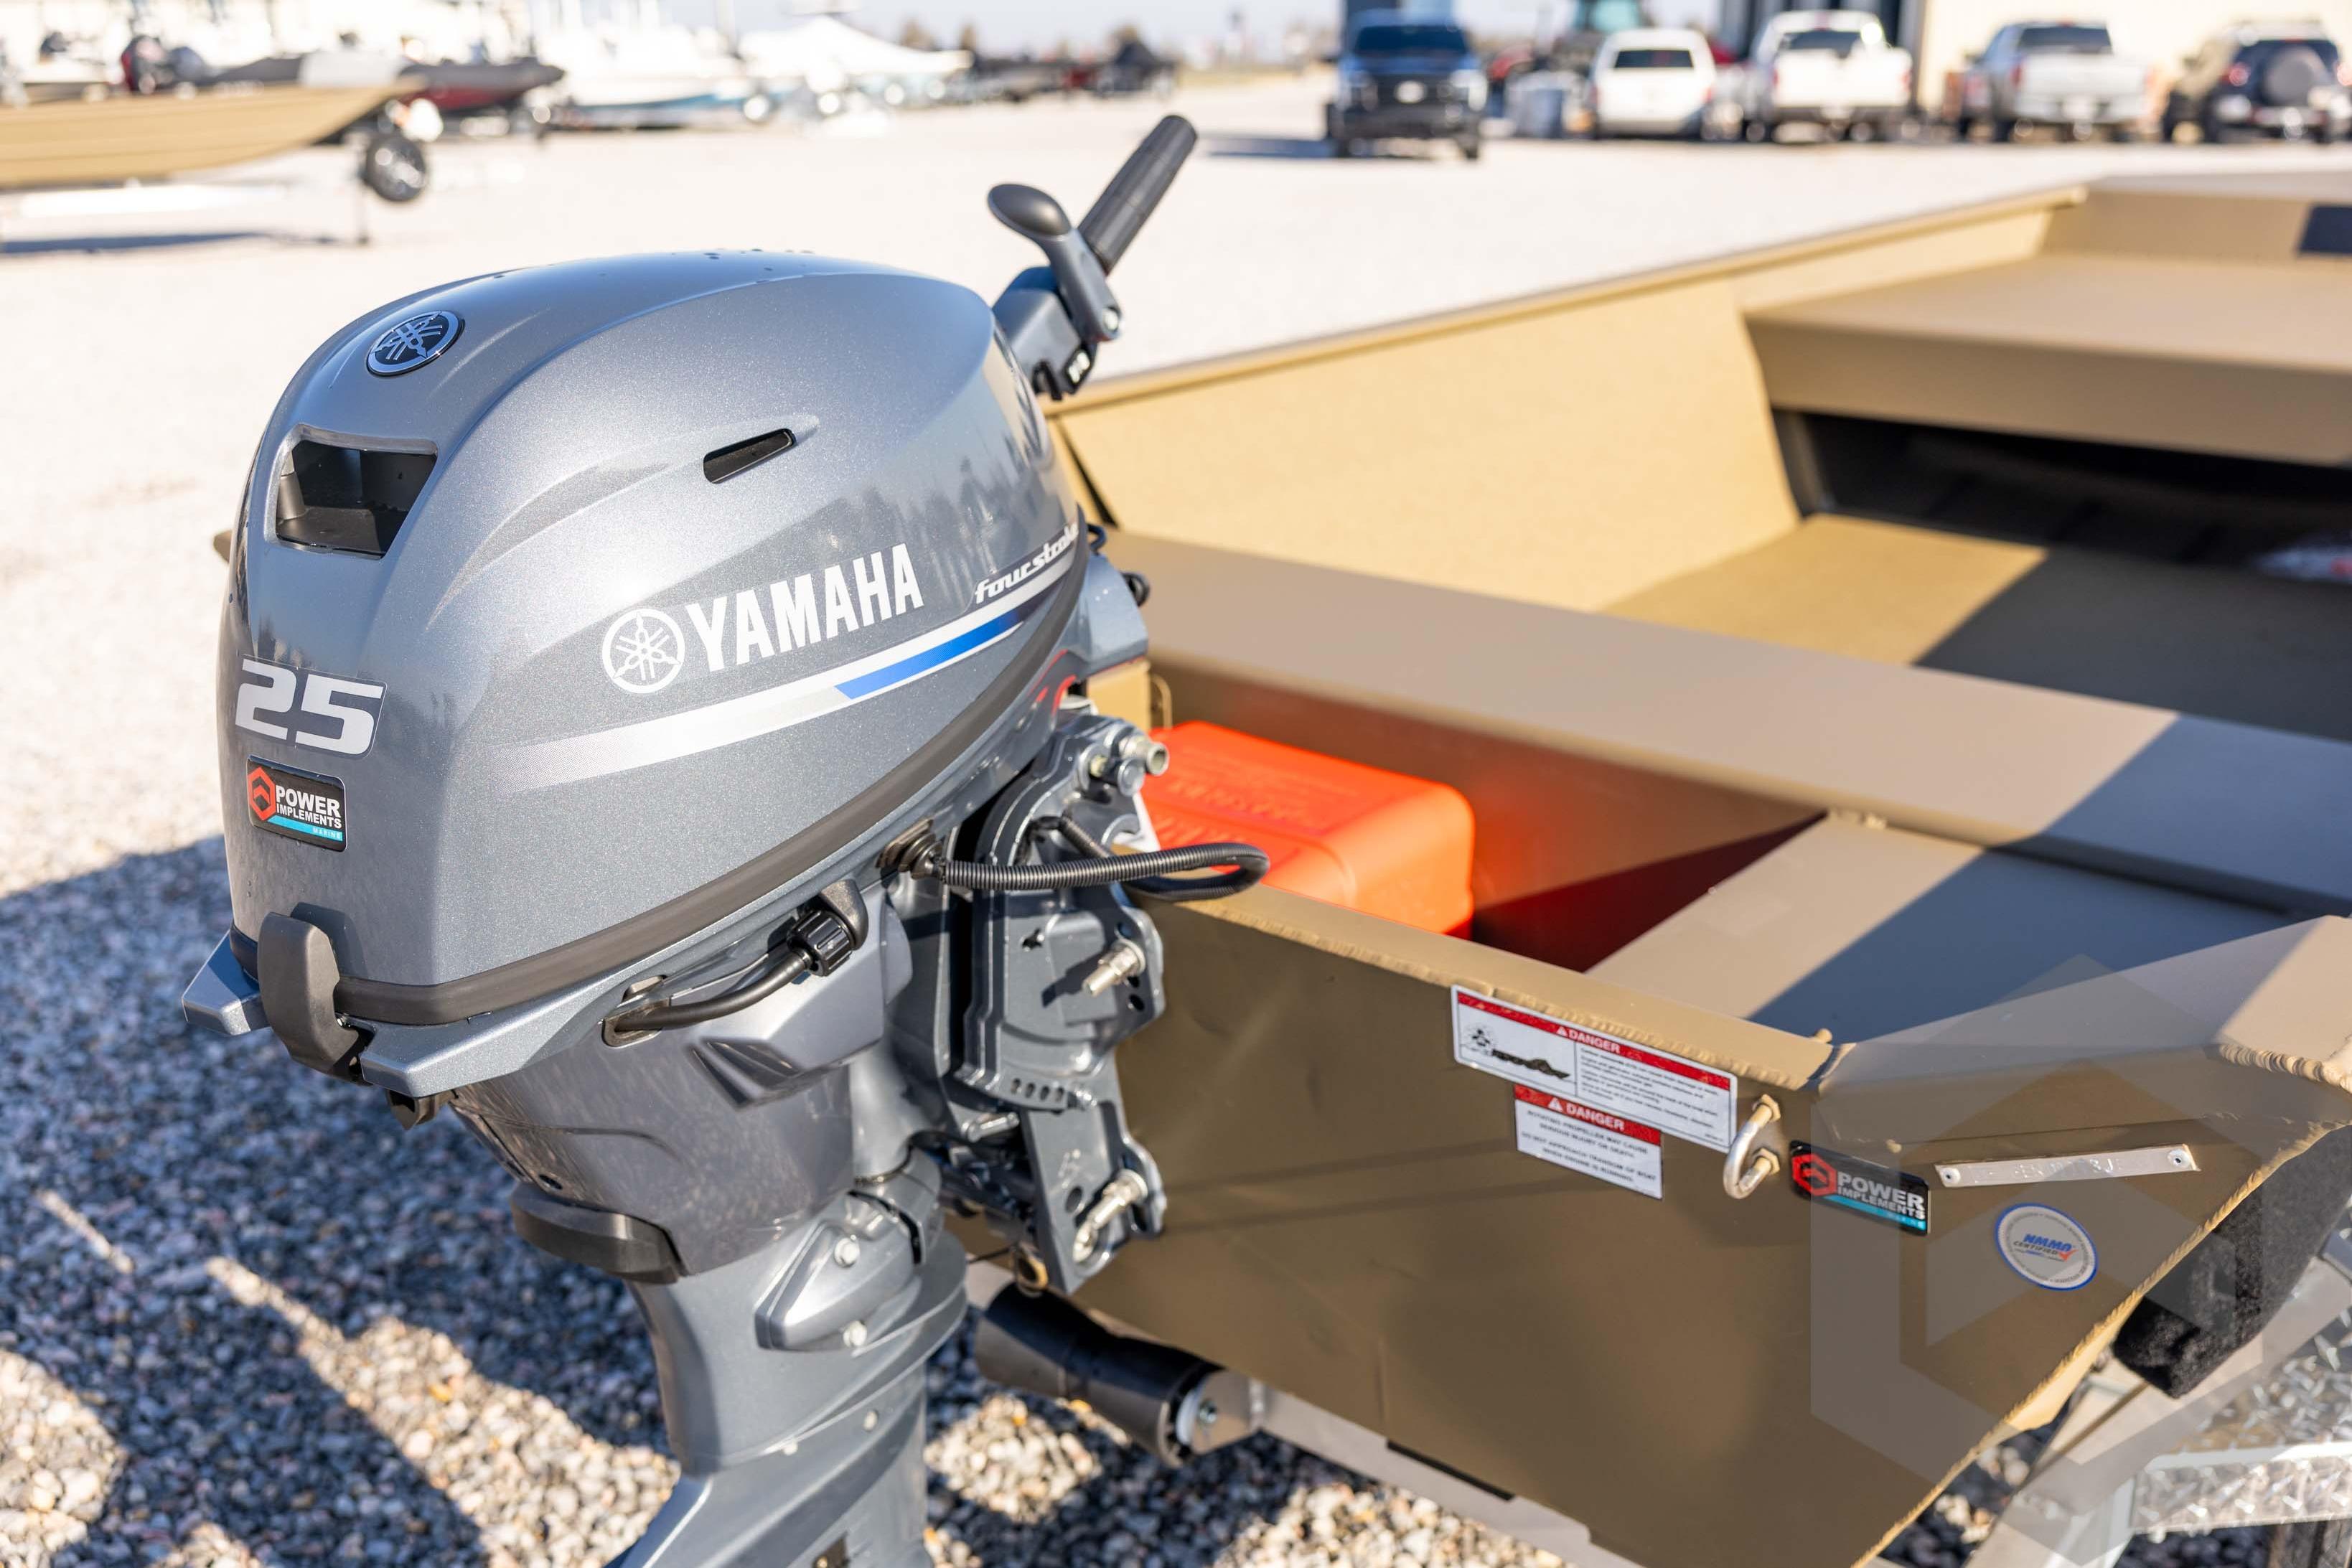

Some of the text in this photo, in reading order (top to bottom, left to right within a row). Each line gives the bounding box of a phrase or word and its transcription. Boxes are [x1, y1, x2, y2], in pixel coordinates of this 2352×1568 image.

[685, 543, 924, 672] YAMAHA
[235, 658, 384, 755] 25
[276, 784, 341, 818] POWER
[276, 802, 342, 829] IMPLEMENTS
[1568, 1028, 1621, 1054] DANGER
[1566, 1102, 1625, 1132] DANGER
[1837, 1171, 1925, 1211] POWER
[1837, 1186, 1926, 1220] IMPLEMENTS
[2023, 1234, 2073, 1252] NMMA
